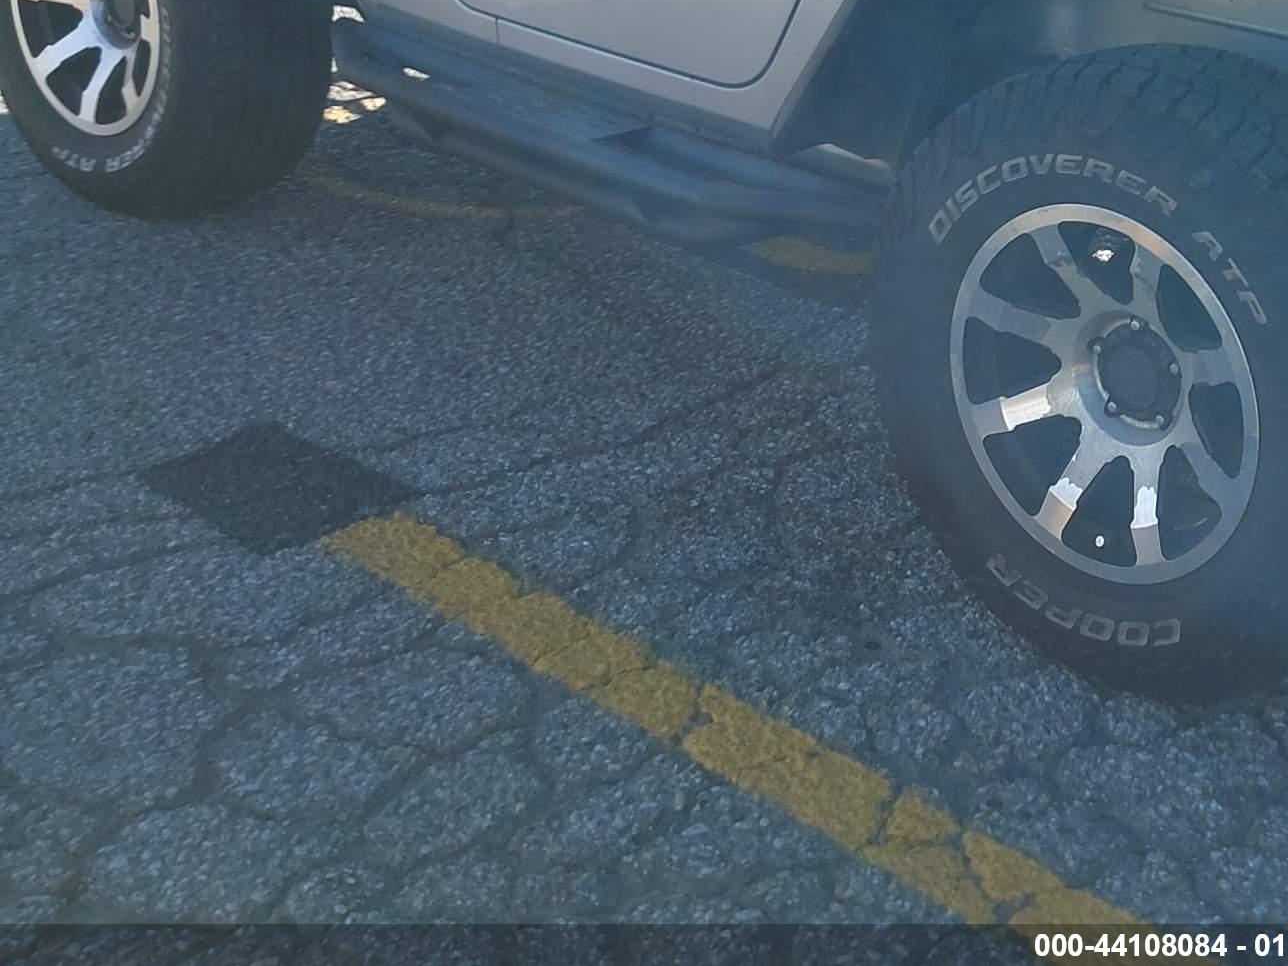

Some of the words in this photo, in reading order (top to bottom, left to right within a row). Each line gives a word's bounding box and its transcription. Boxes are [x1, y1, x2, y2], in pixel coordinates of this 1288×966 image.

[927, 152, 1179, 246] DISCOVERER
[1191, 230, 1269, 326] ATP
[985, 552, 1182, 648] COOPER
